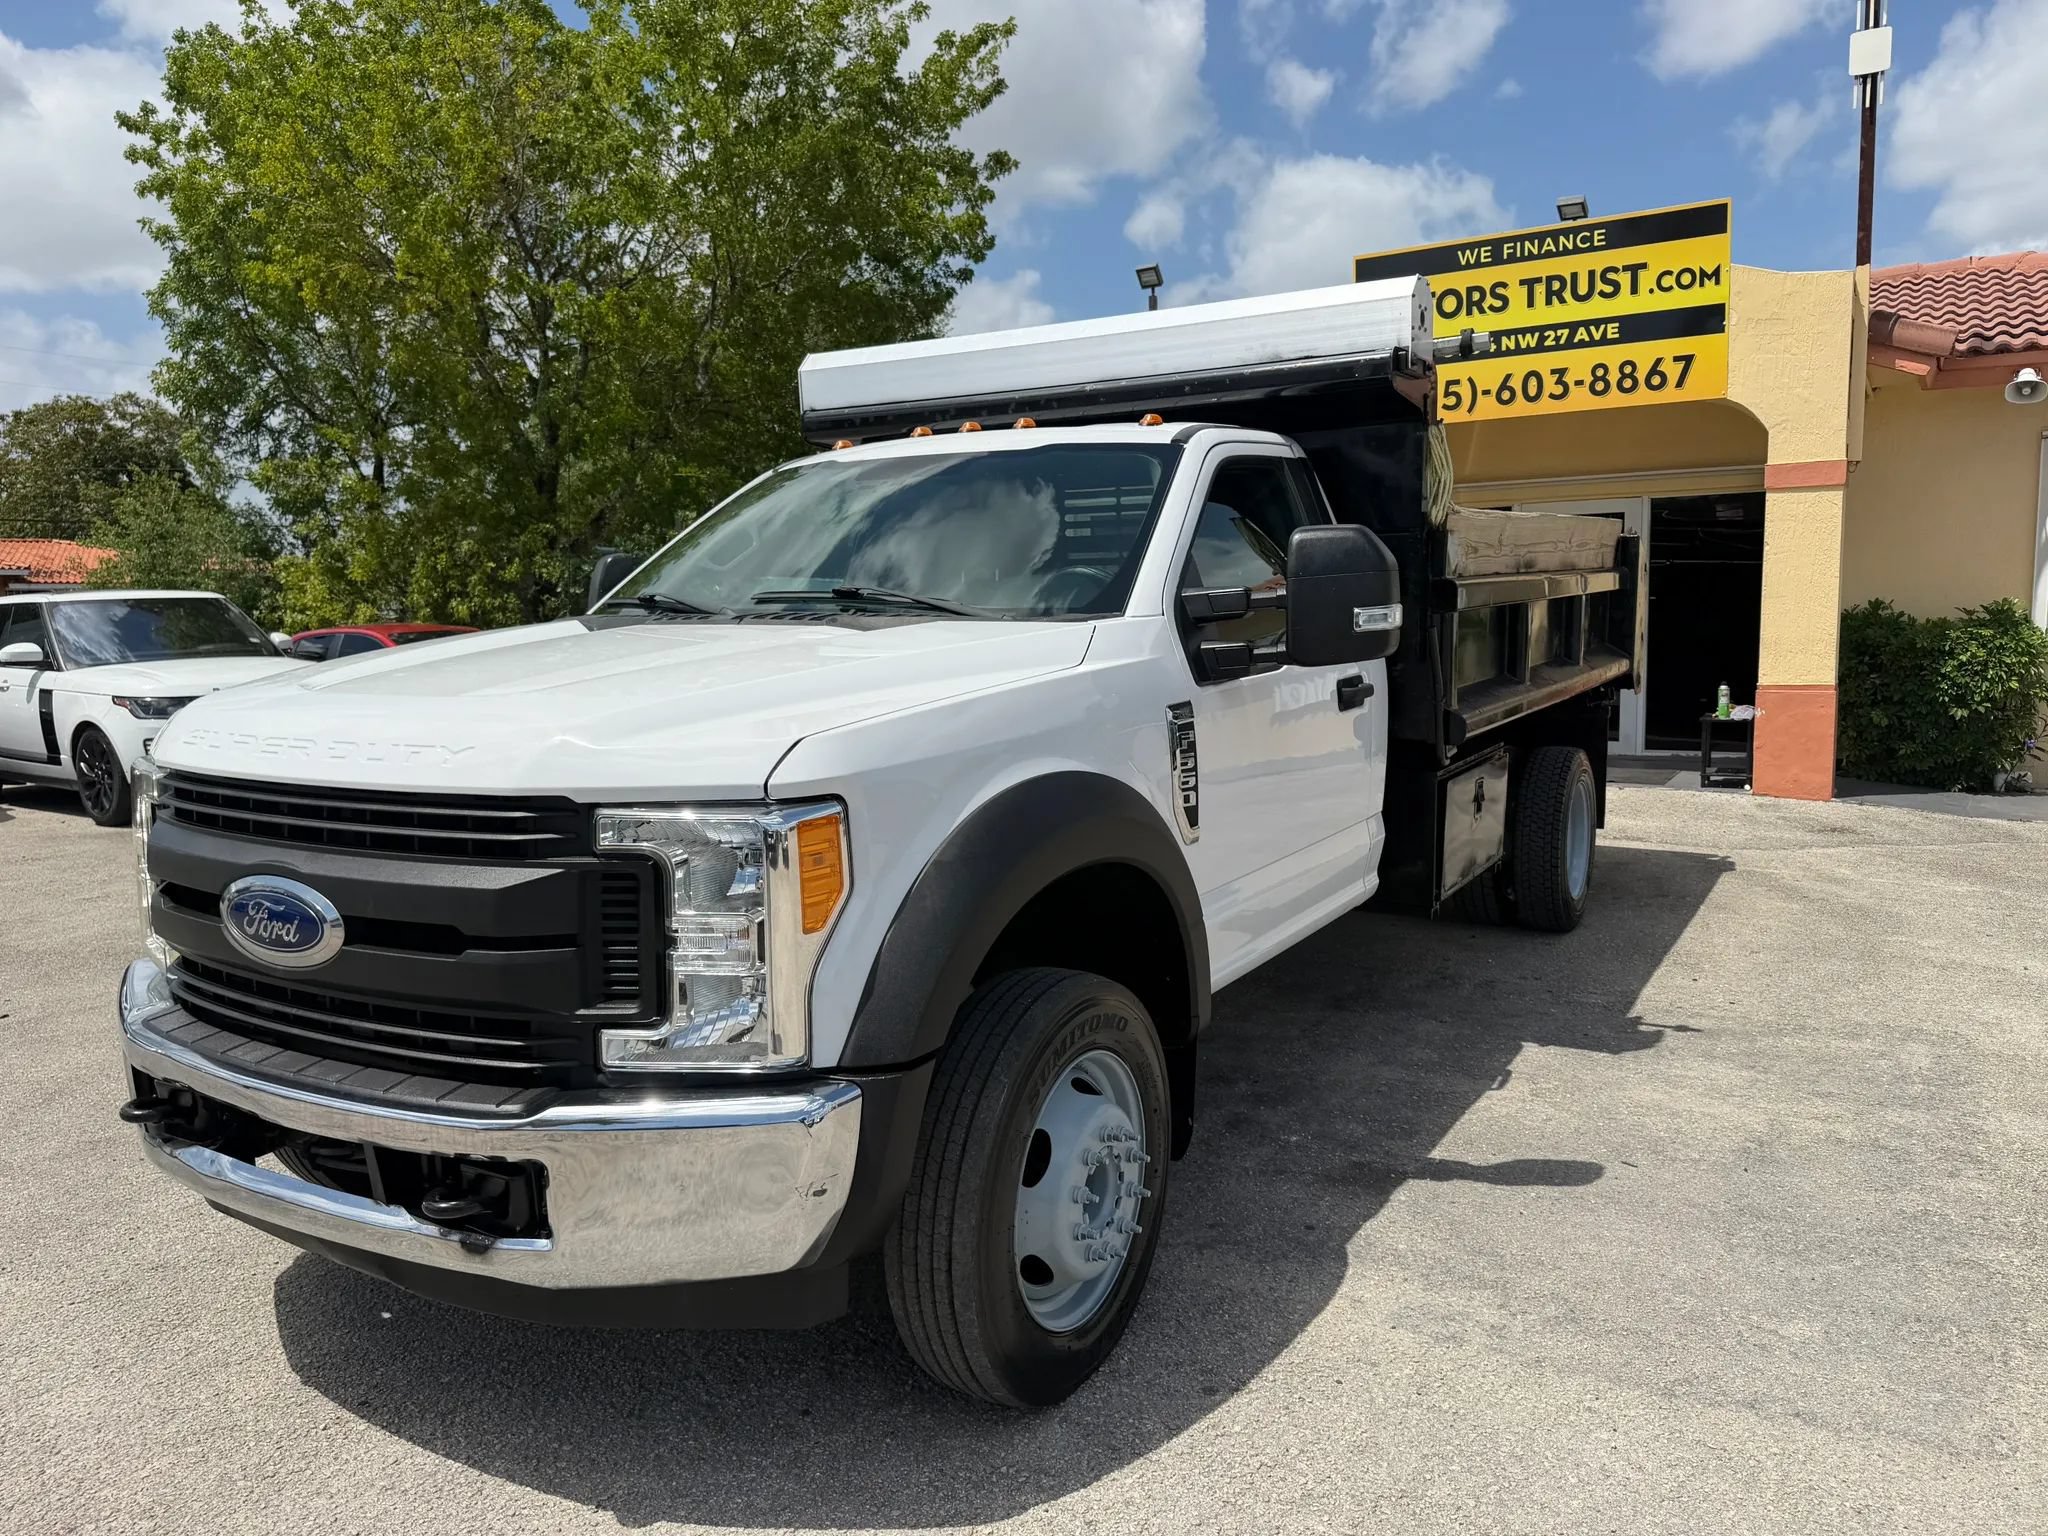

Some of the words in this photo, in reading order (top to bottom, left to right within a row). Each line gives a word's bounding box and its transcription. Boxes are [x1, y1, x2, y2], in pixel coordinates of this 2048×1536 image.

[1458, 246, 1492, 266] WE
[1503, 229, 1607, 260] FINANCE
[1431, 280, 1510, 321] ORS
[1501, 332, 1539, 352] NW
[1544, 329, 1570, 346] 27
[1573, 322, 1620, 343] AVE
[182, 729, 318, 758] SUPER
[327, 739, 477, 767] DUTY
[243, 899, 300, 943] Ford
